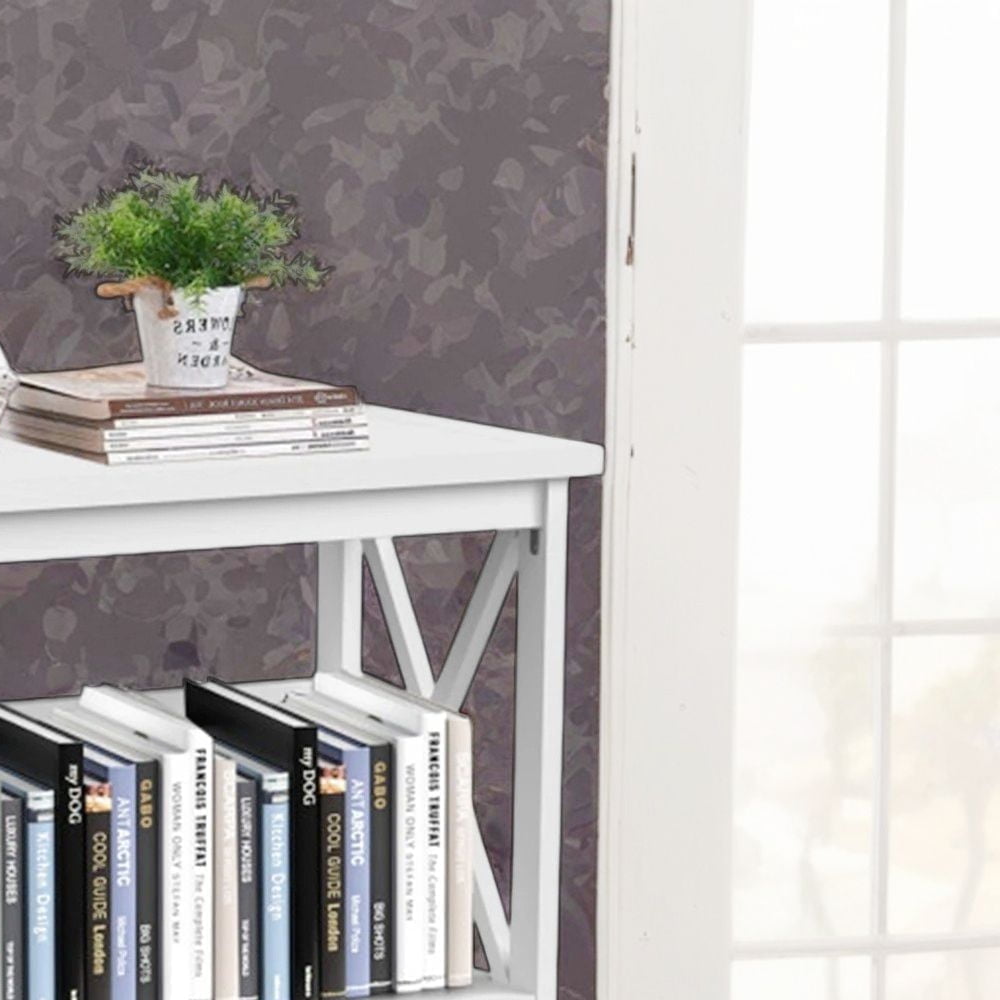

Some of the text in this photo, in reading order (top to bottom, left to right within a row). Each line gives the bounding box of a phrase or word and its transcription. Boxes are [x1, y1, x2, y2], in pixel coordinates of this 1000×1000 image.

[65, 763, 82, 825] my DOG
[300, 746, 316, 806] my DOG
[404, 763, 416, 814] WOMAN
[5, 815, 18, 858] LUXURY
[171, 781, 183, 833] WOMAN
[350, 778, 366, 867] ANTARCTIC
[404, 816, 416, 849] ONLY
[428, 796, 441, 848] TRUFFAT
[116, 796, 131, 888] ANTARCTIC
[171, 836, 183, 868] ONLY
[195, 815, 207, 868] TRUFFAT
[241, 839, 253, 883] HOUSES
[269, 812, 286, 922] Kitchen Design
[372, 761, 387, 961] GABO BIG SHOTS
[5, 860, 18, 904] HOUSES
[34, 831, 51, 943] Kitchen Design
[92, 832, 108, 975] COOL GUIDE London
[139, 778, 153, 984] GABO BIG SHOTS
[327, 812, 342, 952] COOL GUIDE London
